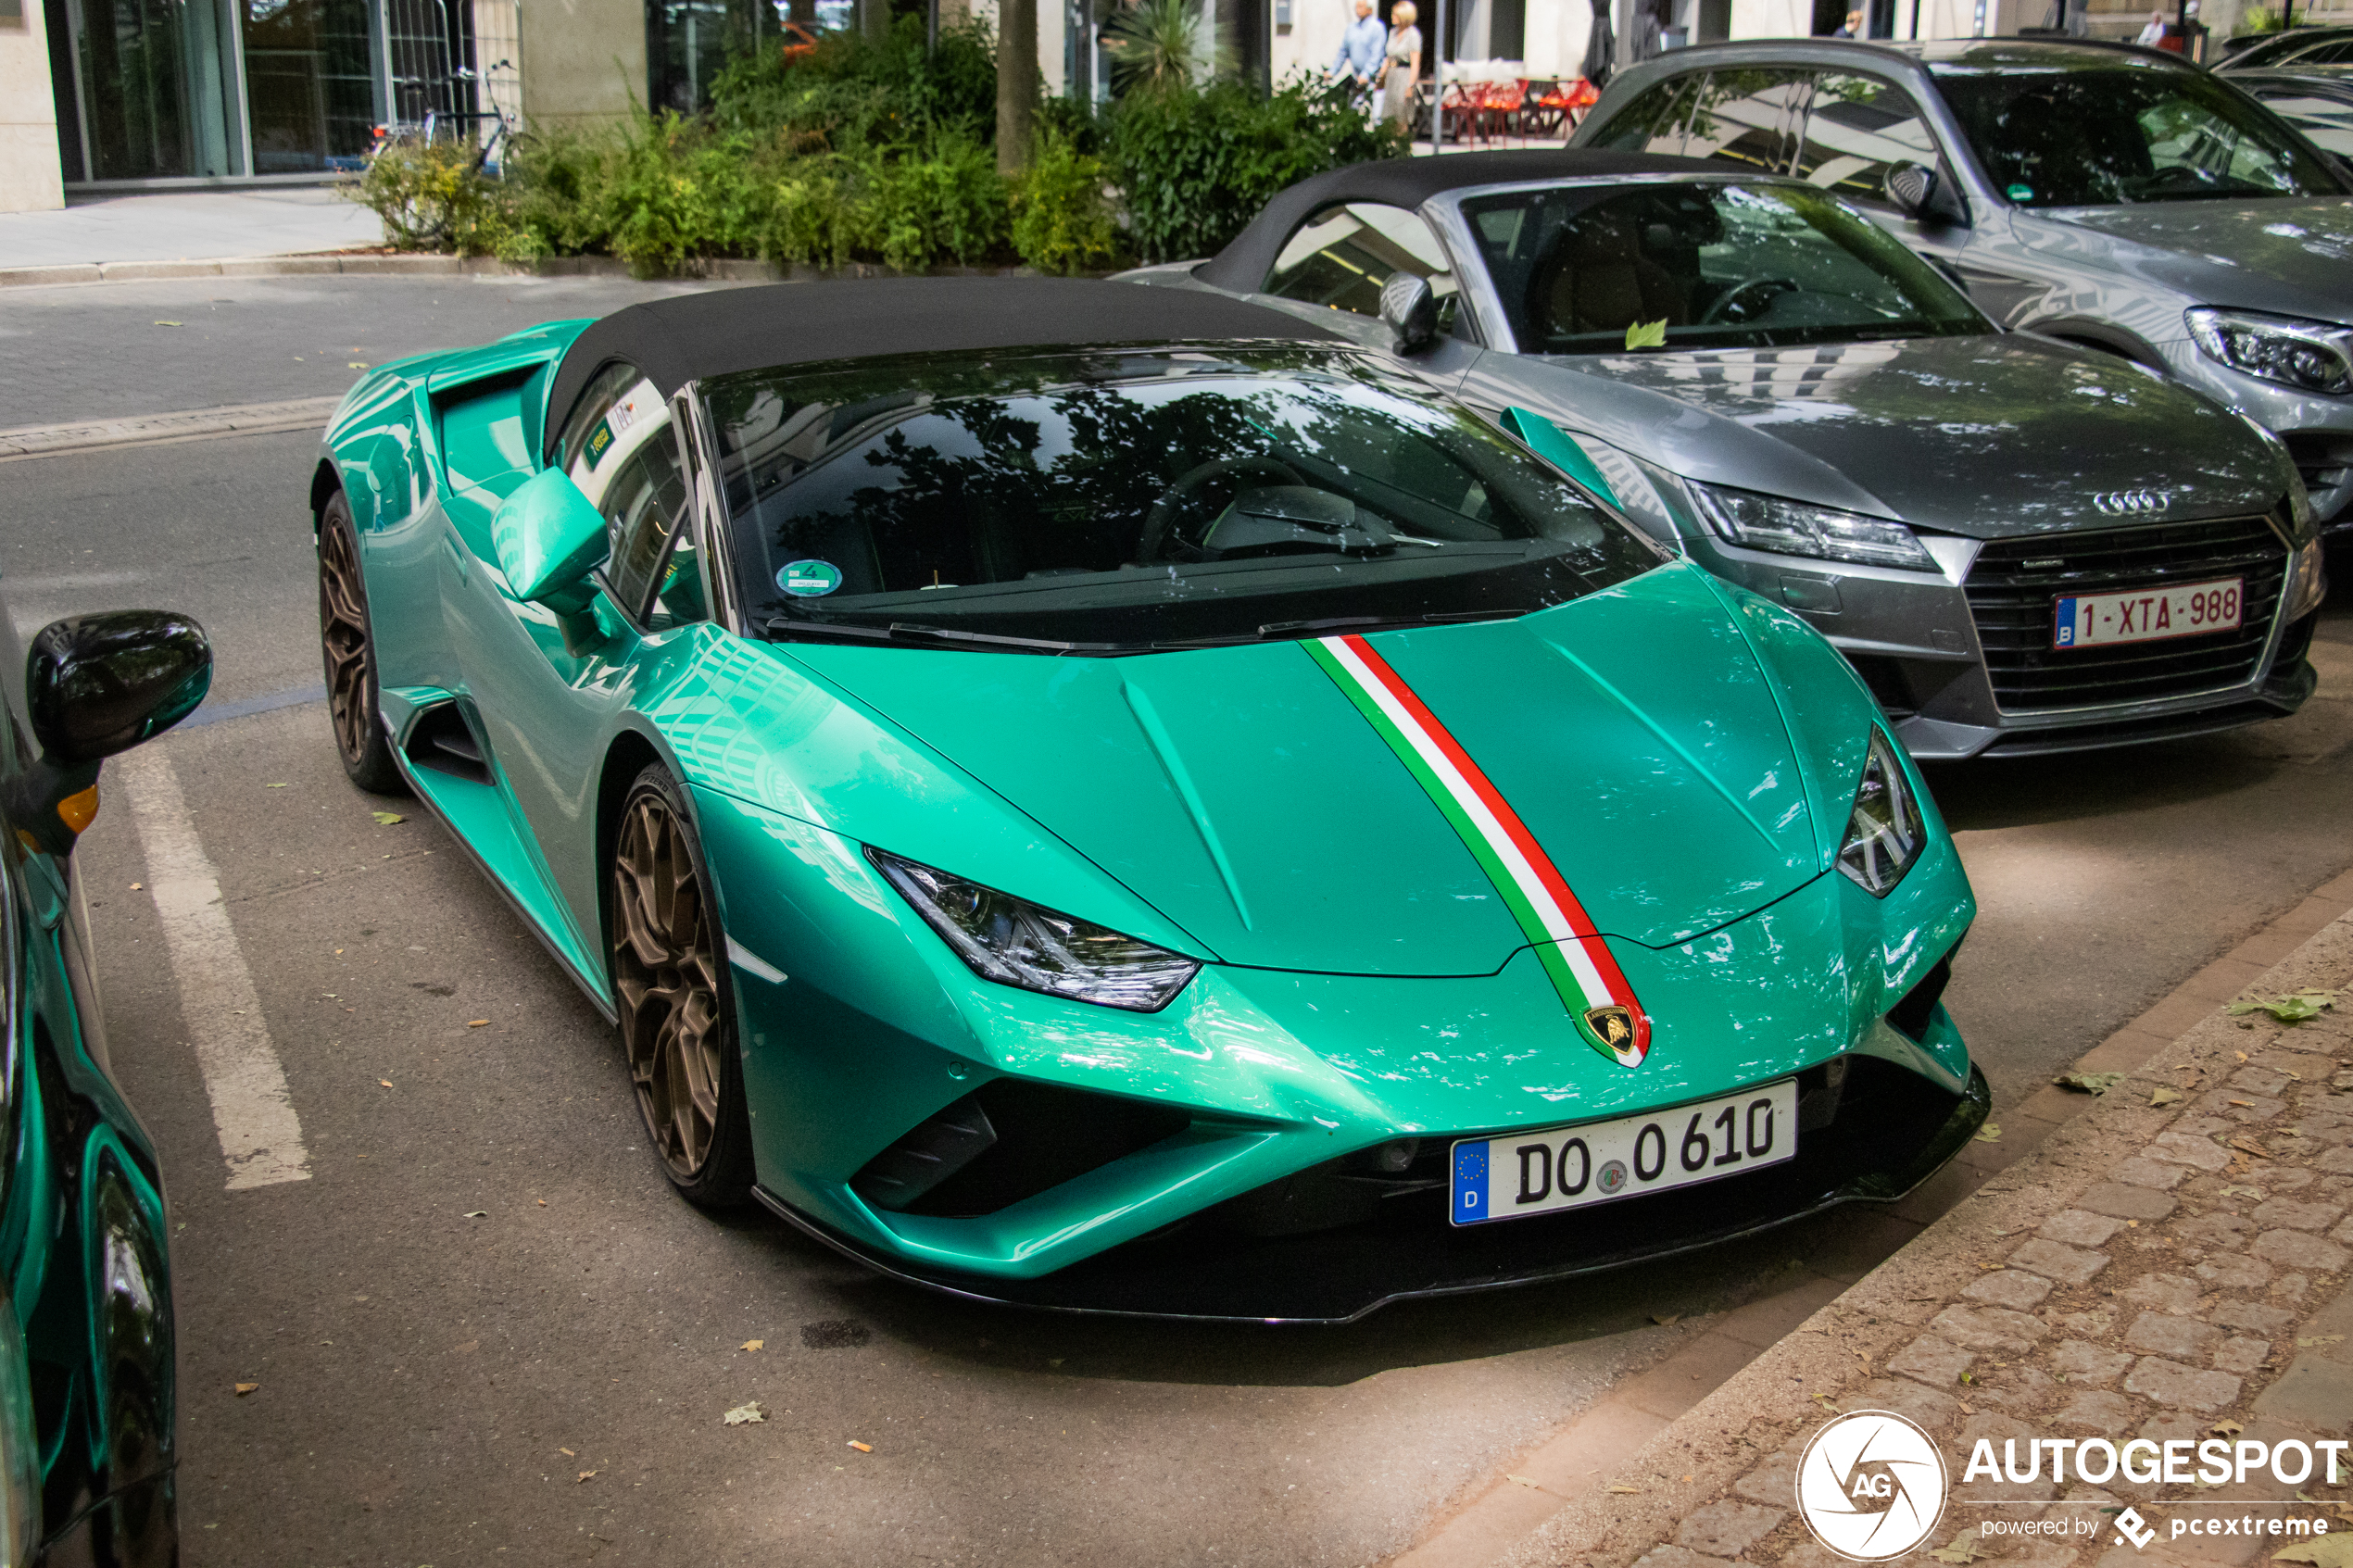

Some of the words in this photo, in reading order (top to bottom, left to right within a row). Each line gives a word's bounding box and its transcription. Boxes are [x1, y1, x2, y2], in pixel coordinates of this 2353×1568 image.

[802, 564, 817, 579] 4
[2082, 586, 2238, 638] 1-XTA-988
[2059, 626, 2071, 643] B
[1588, 1007, 1627, 1021] LAMBORGHINI
[1515, 1137, 1591, 1204] DO
[1633, 1123, 1667, 1182] O
[1680, 1098, 1774, 1173] 610
[1464, 1190, 1478, 1209] D
